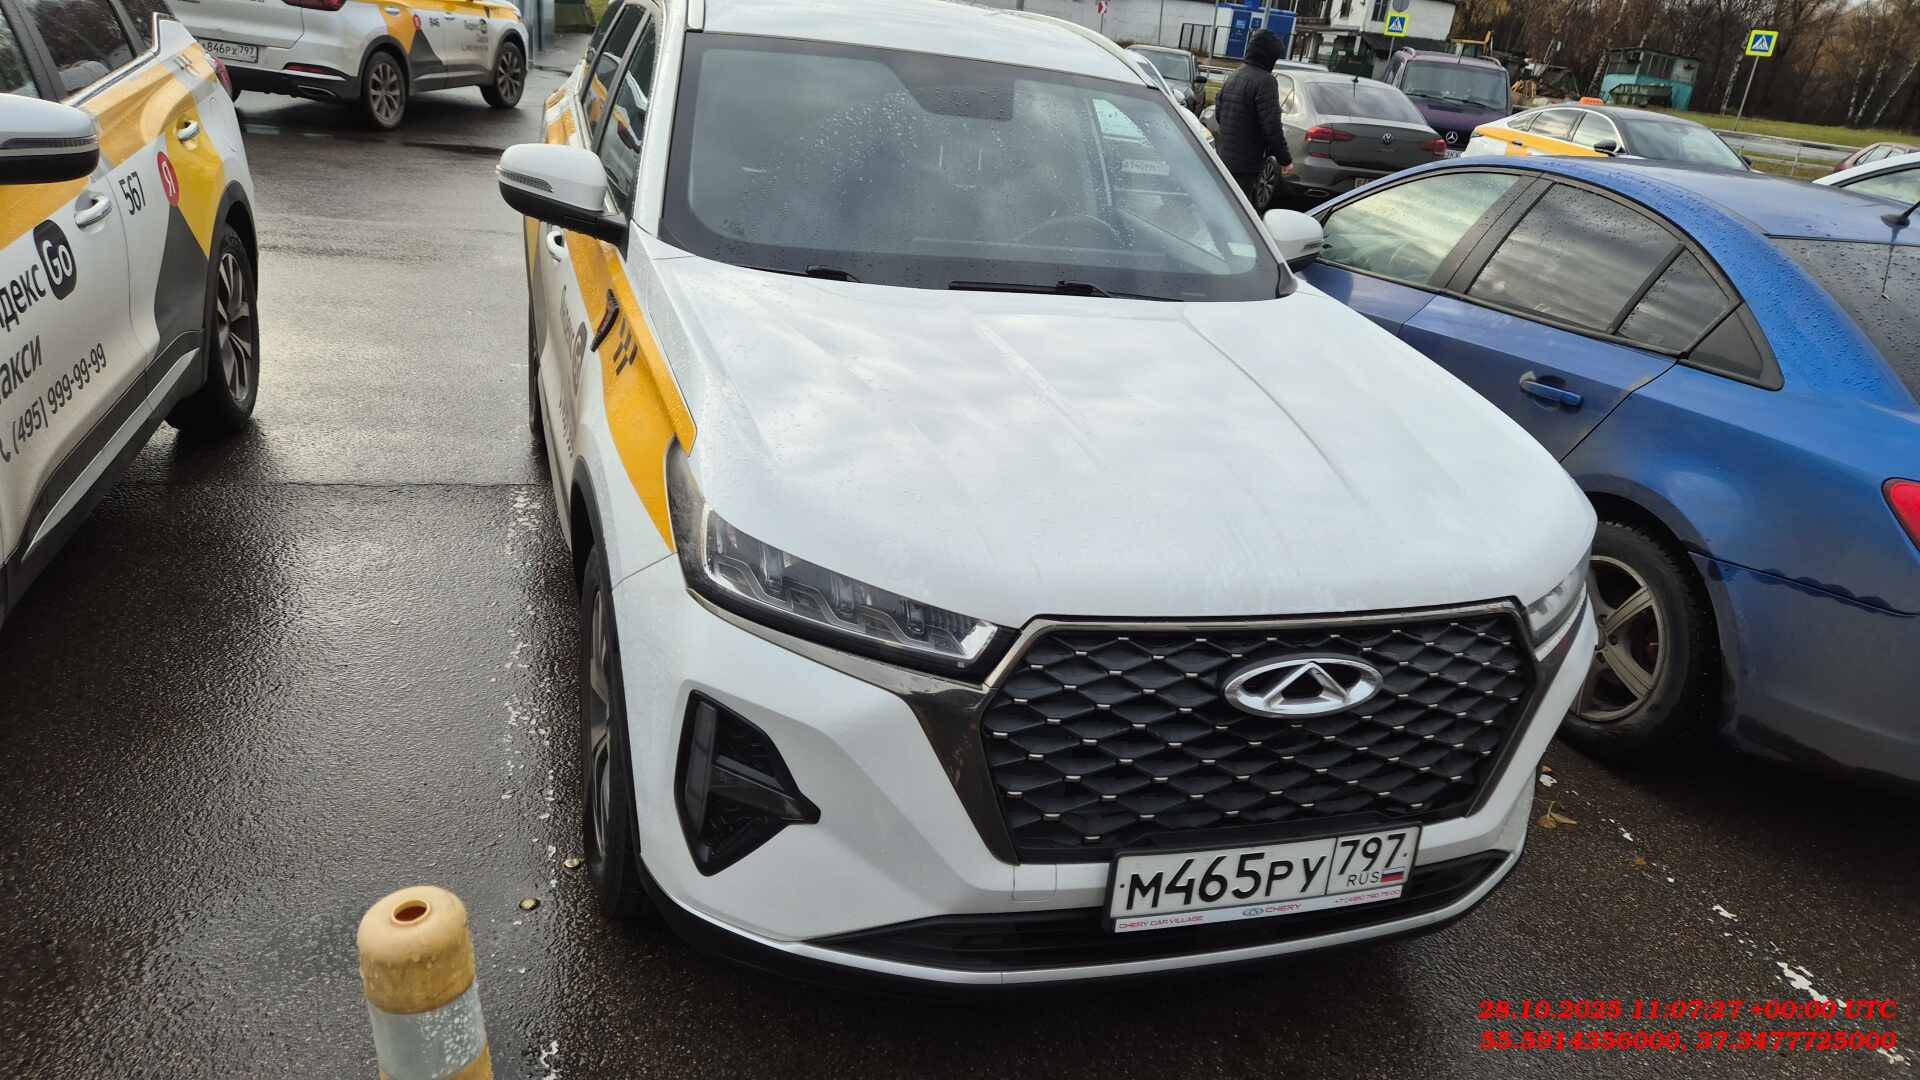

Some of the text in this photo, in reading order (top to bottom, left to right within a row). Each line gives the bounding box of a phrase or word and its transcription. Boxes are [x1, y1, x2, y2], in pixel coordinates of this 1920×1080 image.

[118, 171, 146, 216] 567
[41, 239, 73, 286] Go
[0, 335, 42, 404] акси
[12, 342, 107, 455] (495) 999-99-99
[1126, 832, 1407, 911] М465РУ 797
[1346, 871, 1380, 887] RUS
[1265, 903, 1302, 913] CHERY
